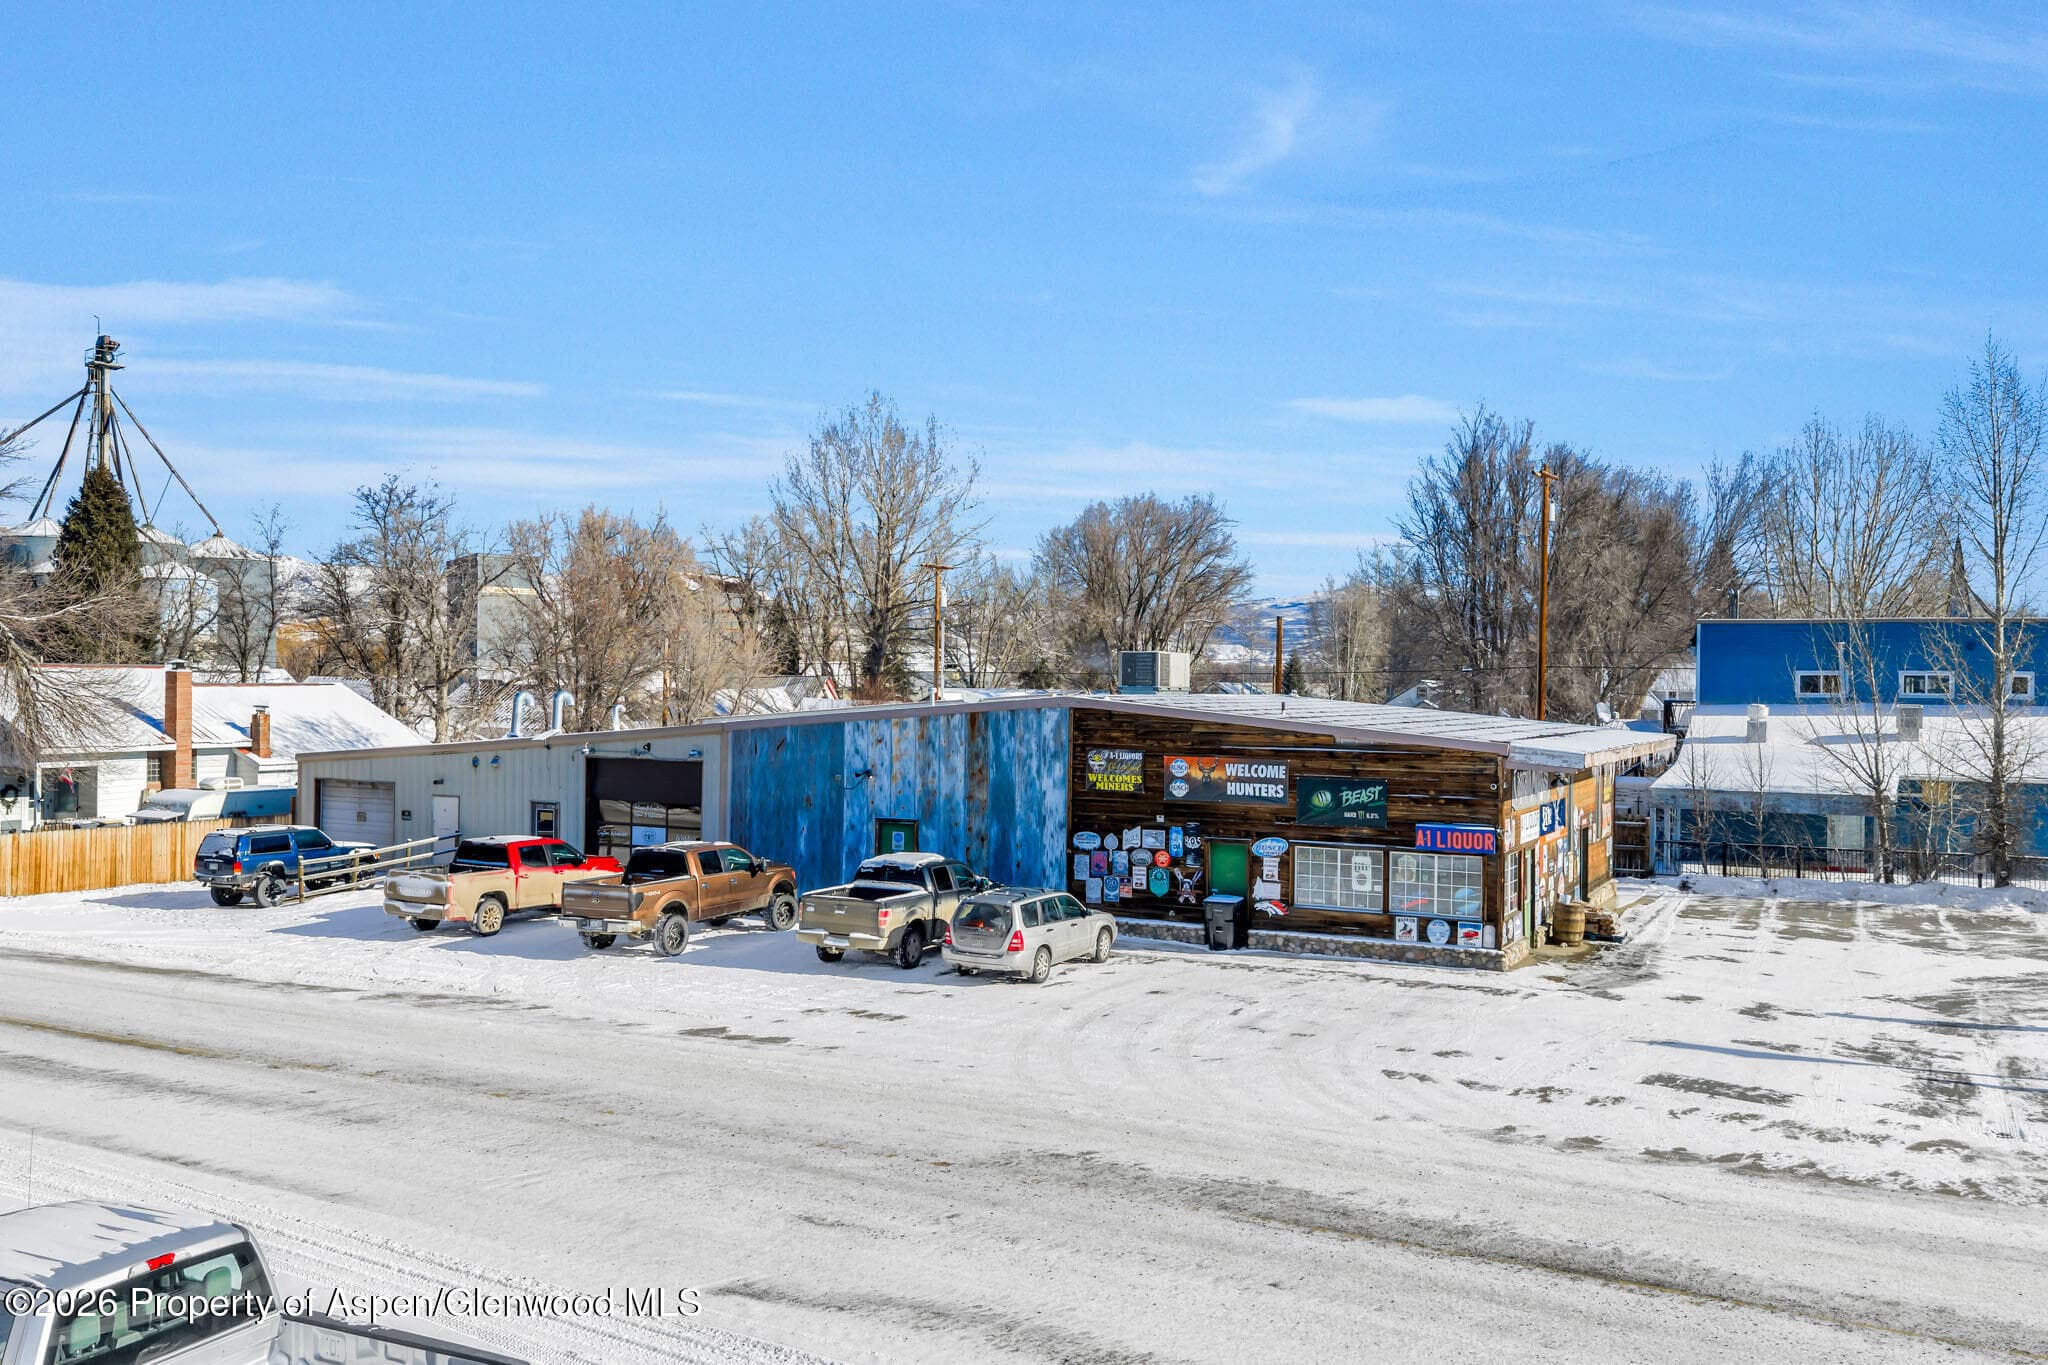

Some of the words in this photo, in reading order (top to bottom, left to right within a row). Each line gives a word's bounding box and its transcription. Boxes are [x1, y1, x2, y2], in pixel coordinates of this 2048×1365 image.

[1119, 752, 1143, 761] LIQUORS
[1225, 763, 1287, 779] WELCOME
[1088, 773, 1143, 784] WELCOMES
[1096, 782, 1135, 792] MINERS
[1226, 782, 1284, 798] HUNTERS
[1339, 786, 1383, 807] BEAST
[1184, 836, 1202, 848] 805
[1436, 831, 1494, 851] LIQUOR
[1256, 844, 1286, 852] BUSCH
